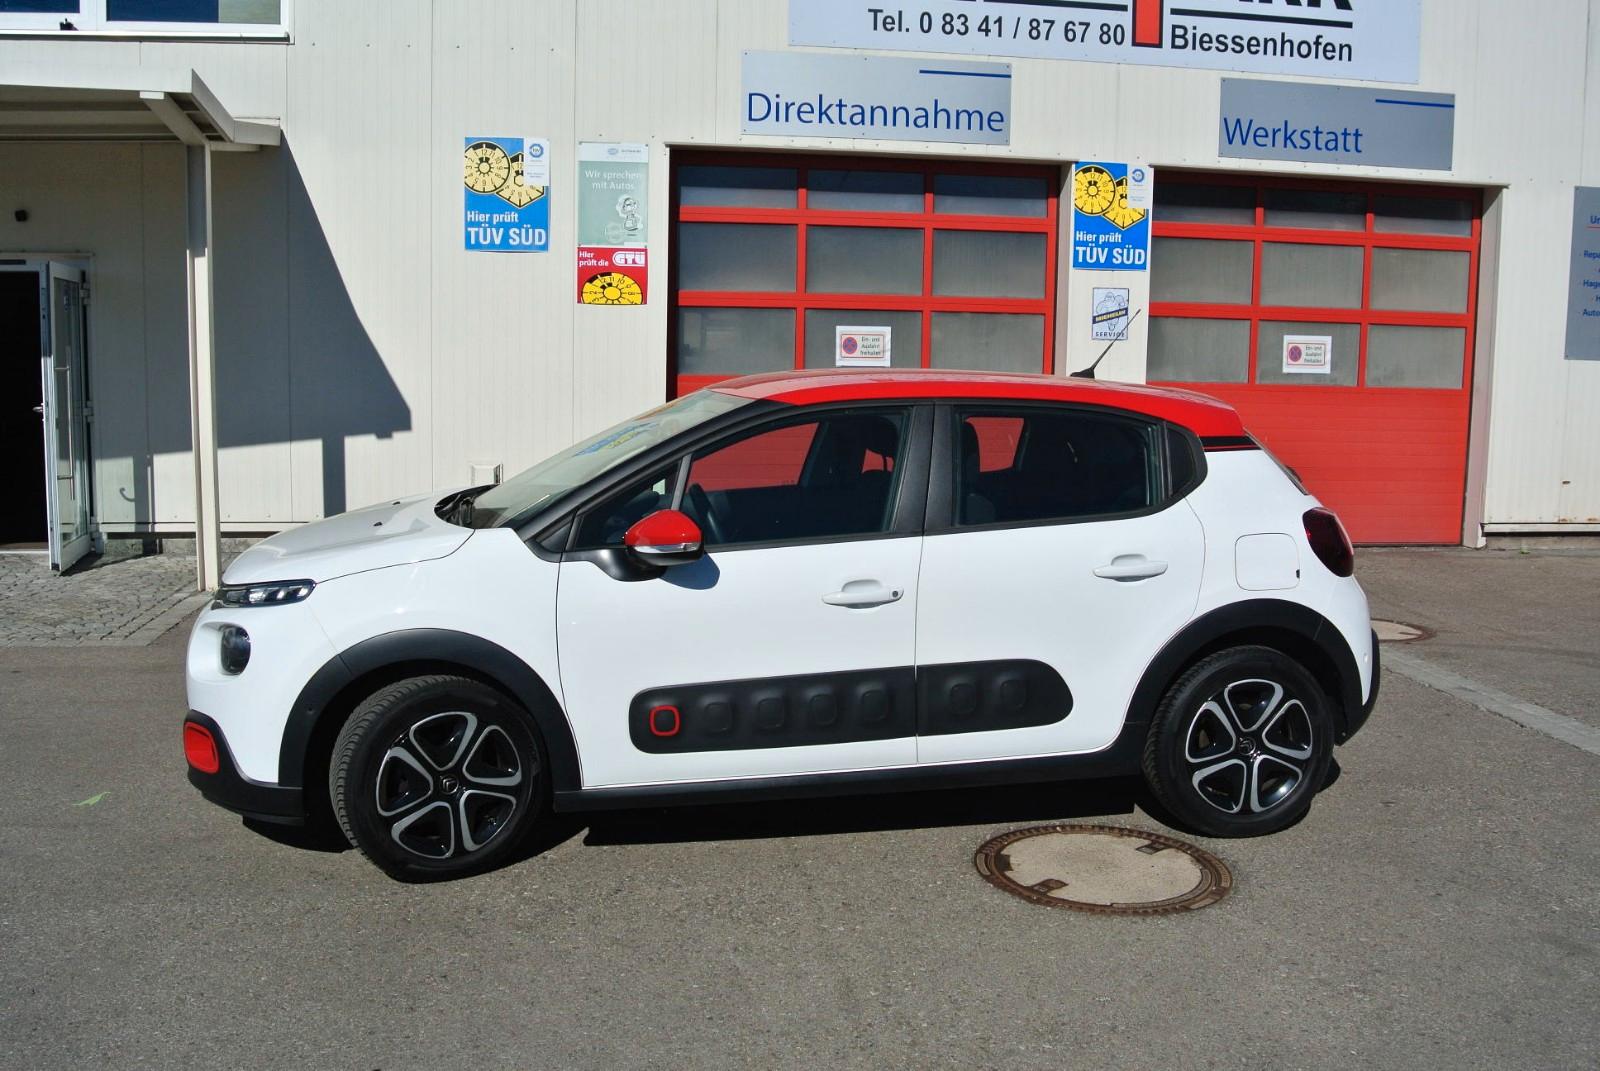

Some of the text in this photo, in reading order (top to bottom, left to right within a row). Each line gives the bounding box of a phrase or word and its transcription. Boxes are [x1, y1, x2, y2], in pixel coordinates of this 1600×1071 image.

[868, 8, 910, 33] Tel.
[919, 11, 933, 33] 0
[941, 12, 969, 36] 83
[977, 15, 1004, 38] 41
[1028, 18, 1055, 41] 87
[1064, 20, 1091, 43] 67
[1099, 22, 1126, 45] 80
[1170, 24, 1353, 62] Biessenhofen
[747, 92, 1005, 132] Direktannahme
[1223, 117, 1363, 153] Werkstatt
[585, 170, 641, 181] Wir sprechen
[592, 181, 607, 190] mit
[467, 210, 519, 225] Hier prüft
[467, 224, 546, 246] TÜV SÜD
[1076, 231, 1122, 244] Hier prüft
[579, 258, 609, 267] prüft die
[1076, 243, 1145, 265] TÜV SÜD
